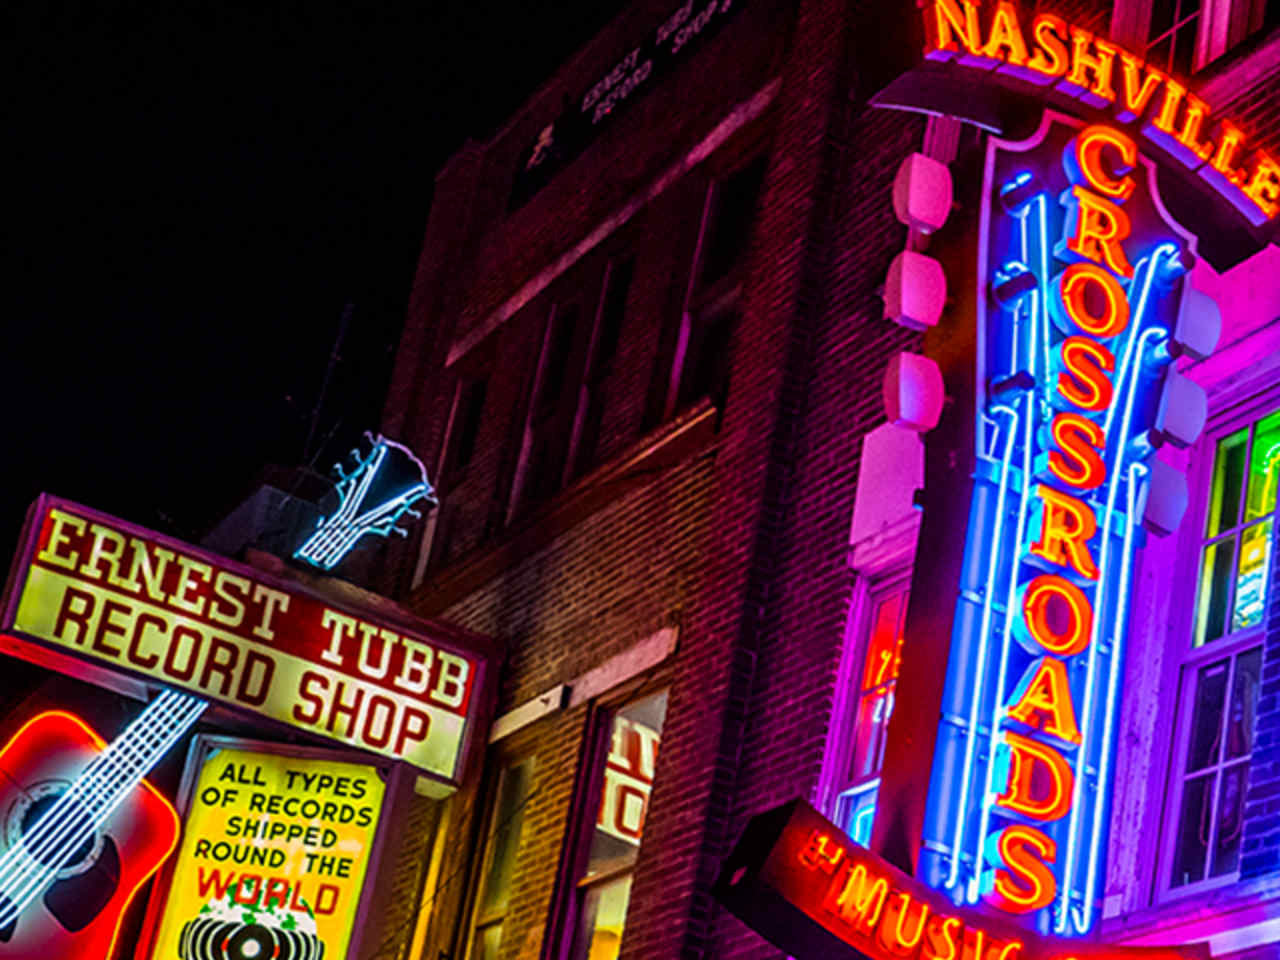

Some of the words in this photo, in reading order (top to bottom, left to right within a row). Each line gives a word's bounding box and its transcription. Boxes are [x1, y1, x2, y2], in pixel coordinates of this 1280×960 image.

[986, 122, 1137, 916] CROSSROADS
[38, 508, 290, 640] ERNEST
[321, 608, 471, 709] TUBB
[53, 587, 276, 708] RECORD
[293, 671, 431, 755] SHOP
[219, 763, 266, 786] ALL
[285, 769, 367, 799] TYPES
[200, 787, 238, 807] OF
[249, 794, 373, 827] RECORDS
[225, 816, 338, 849] SHIPPED
[194, 838, 286, 869] ROUND
[305, 853, 353, 879] THE
[197, 867, 340, 916] WORLD
